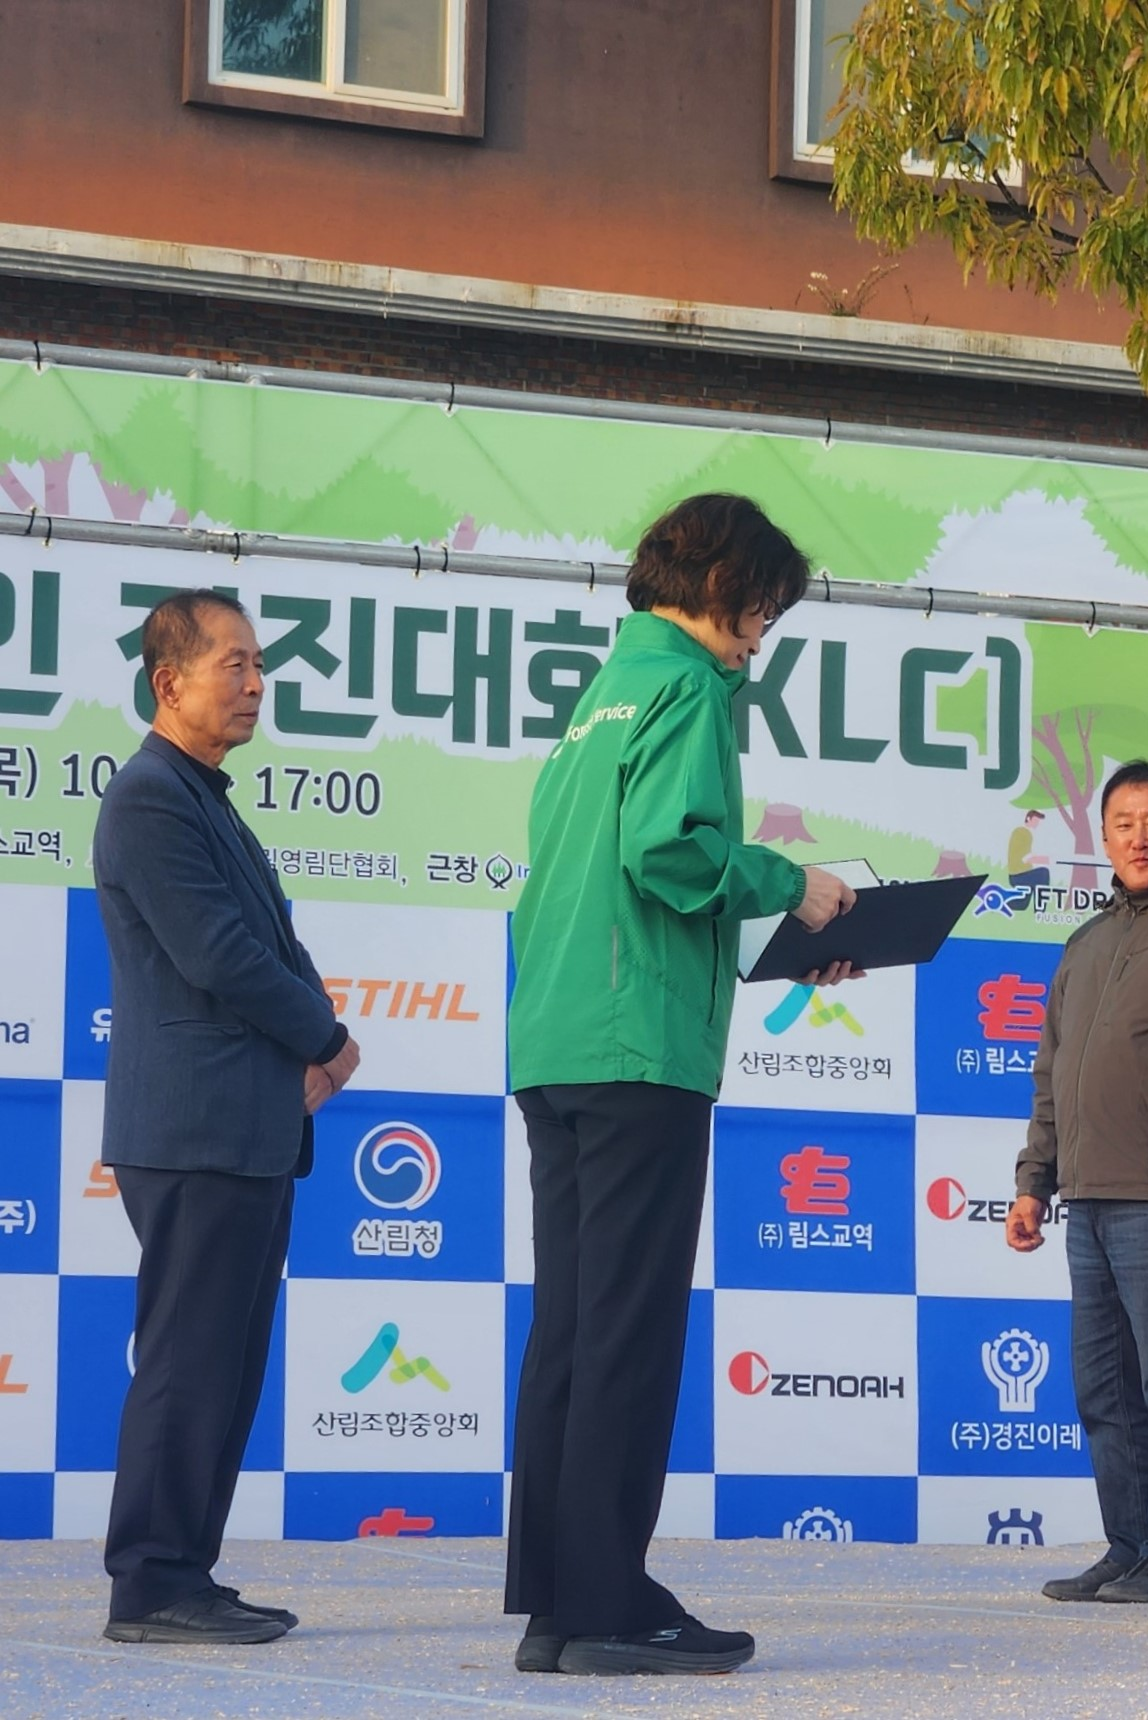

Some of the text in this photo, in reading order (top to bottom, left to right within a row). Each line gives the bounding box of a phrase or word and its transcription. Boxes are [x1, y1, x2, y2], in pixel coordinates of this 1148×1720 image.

[115, 582, 625, 749] 진대회
[255, 766, 381, 816] 17:00
[427, 854, 478, 883] 근창
[1036, 887, 1067, 909] FT
[1036, 912, 1082, 924] FUSION
[323, 978, 480, 1021] STIHL
[738, 1051, 892, 1081] 산림조합중앙회
[956, 1047, 980, 1075] (주)
[355, 1222, 440, 1256] 산림청
[758, 1221, 873, 1252] (주) 림스교역
[771, 1373, 905, 1398] ZENOAH
[312, 1411, 480, 1438] 산림조합중앙회
